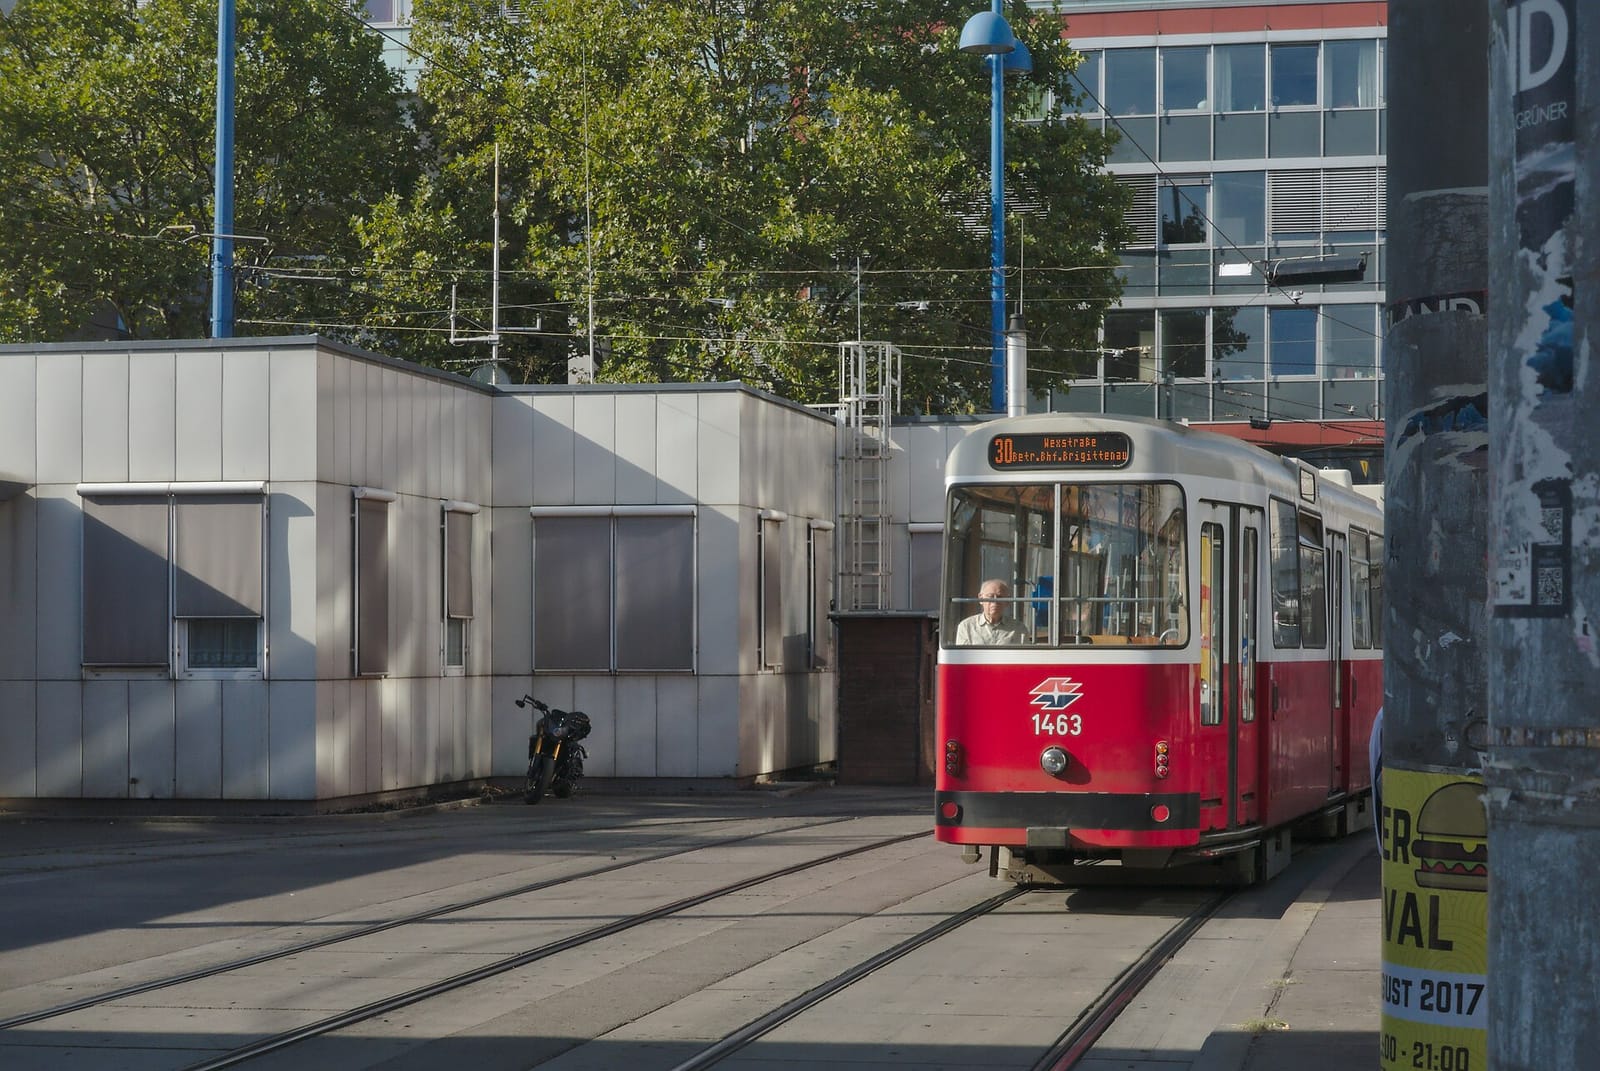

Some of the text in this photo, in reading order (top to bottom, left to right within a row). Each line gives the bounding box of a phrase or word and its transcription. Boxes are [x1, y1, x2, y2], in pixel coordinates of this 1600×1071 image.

[994, 438, 1013, 464] 30
[1032, 713, 1082, 736] 1463
[1383, 887, 1453, 951] VAL
[1382, 974, 1485, 1015] UST 2017
[1413, 1041, 1469, 1071] 21:00
